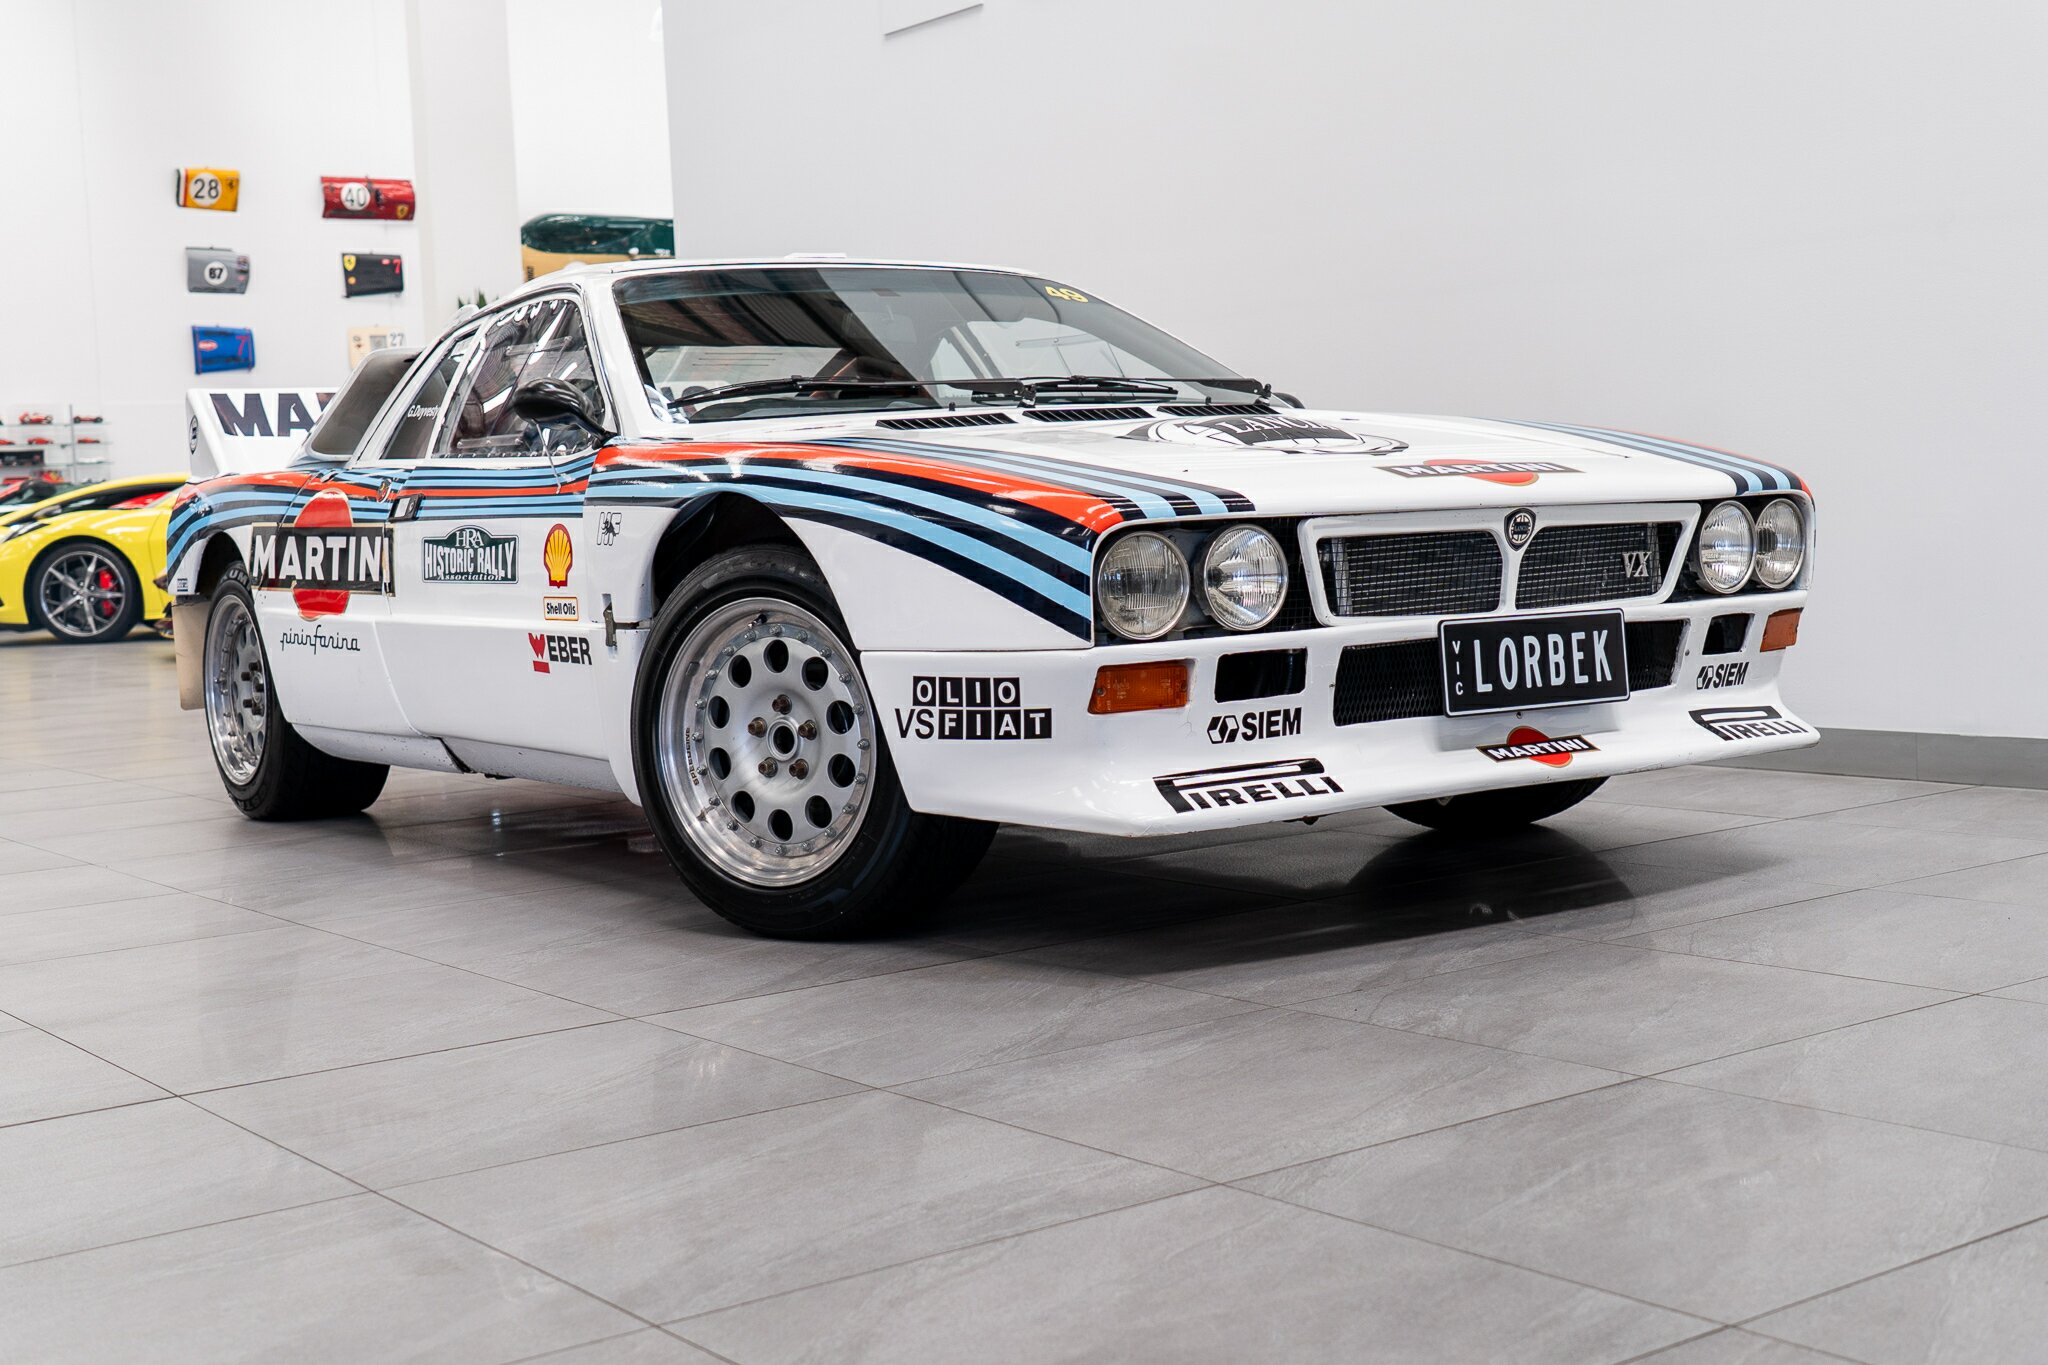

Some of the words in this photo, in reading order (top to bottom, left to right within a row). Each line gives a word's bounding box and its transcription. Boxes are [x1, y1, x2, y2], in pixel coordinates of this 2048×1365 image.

[194, 178, 219, 199] 28
[345, 188, 367, 207] 40
[235, 335, 250, 356] 7
[389, 332, 404, 346] 27
[210, 392, 336, 437] MA
[408, 405, 441, 420] G.Duyvesty
[1391, 462, 1566, 476] MARTINI
[455, 529, 484, 548] HRA
[252, 534, 391, 584] MARTINI
[424, 542, 475, 579] HISTORIC
[477, 540, 515, 579] RALLY
[1622, 551, 1652, 578] VX
[437, 571, 502, 581] Association
[546, 602, 562, 615] Shell
[562, 602, 576, 615] Oils
[280, 624, 360, 654] pininfarina
[528, 632, 592, 666] WEBER
[1452, 640, 1464, 695] VIC
[1473, 629, 1613, 693] LORBEK
[1713, 662, 1750, 688] SIEM
[915, 679, 1017, 704] OLIO
[894, 708, 935, 739] VS
[944, 712, 1046, 736] FIAT
[1241, 707, 1302, 742] SIEM
[1688, 705, 1808, 741] PIRELLI
[1487, 738, 1590, 759] MARTINI
[1152, 757, 1345, 814] PIRELLI
